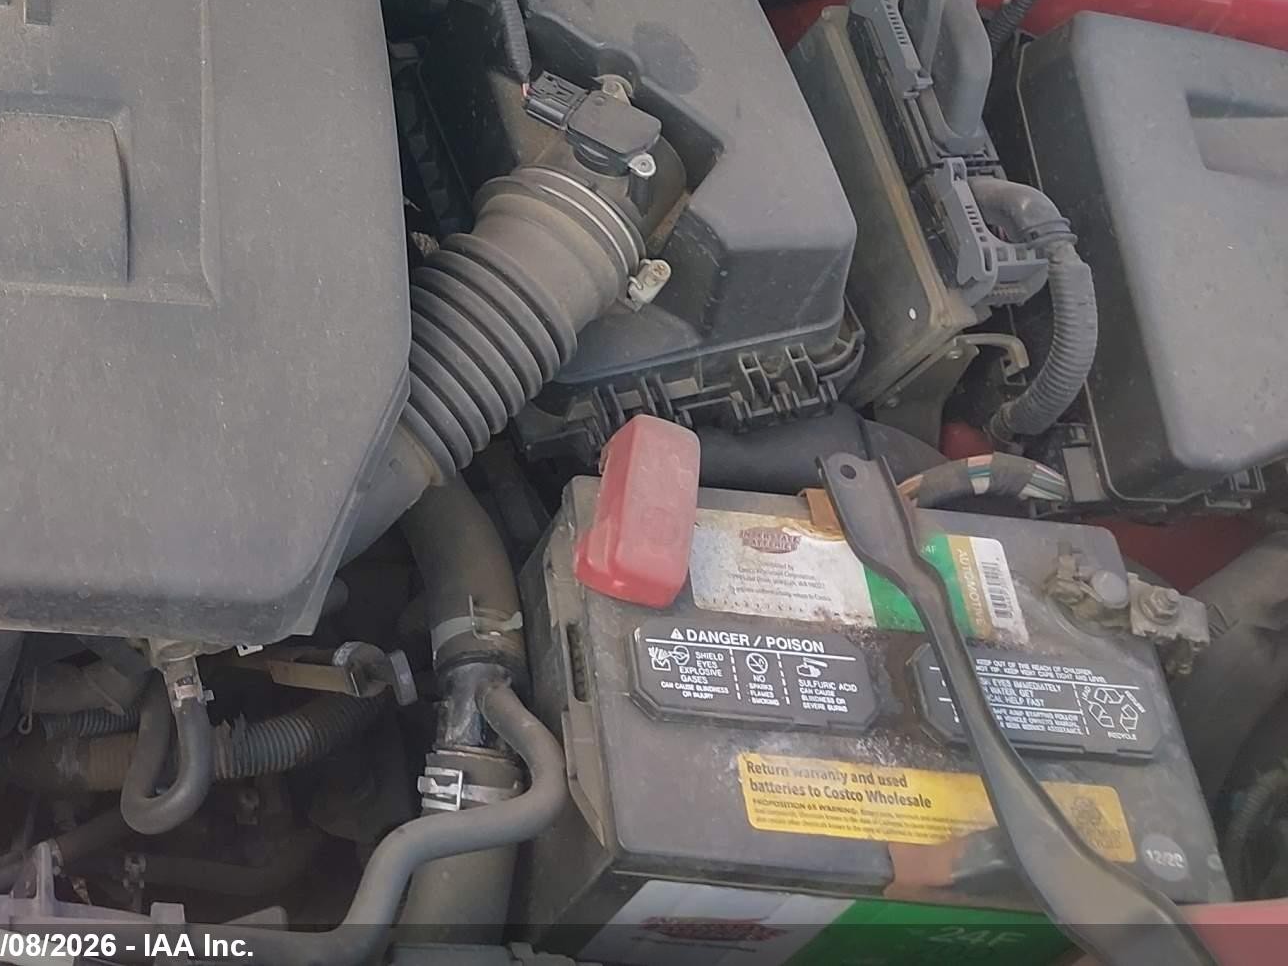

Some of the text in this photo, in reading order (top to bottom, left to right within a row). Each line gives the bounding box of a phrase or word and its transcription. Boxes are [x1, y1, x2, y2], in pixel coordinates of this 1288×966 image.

[687, 629, 750, 647] DANGER
[766, 636, 825, 654] POISON
[695, 651, 724, 661] SHIELD
[696, 660, 718, 669] EYES
[993, 659, 1006, 667] OUT
[679, 666, 723, 677] EXPLOSIVE
[680, 674, 709, 684] GASES
[753, 674, 766, 683] NO
[660, 680, 673, 688] CAN
[675, 682, 695, 691] CAUSE
[798, 679, 858, 692] SULFURIC ACID
[991, 678, 1012, 688] EYES
[1013, 680, 1061, 692] IMMEDIATELY
[799, 687, 836, 697] CAN CAUSE
[1019, 689, 1034, 698] GET
[1005, 695, 1025, 705] HELP
[1025, 697, 1045, 706] FAST
[747, 761, 909, 788] Return warranty and used
[750, 777, 932, 809] batteries to Costco Wholesale
[926, 925, 1026, 945] 24F
